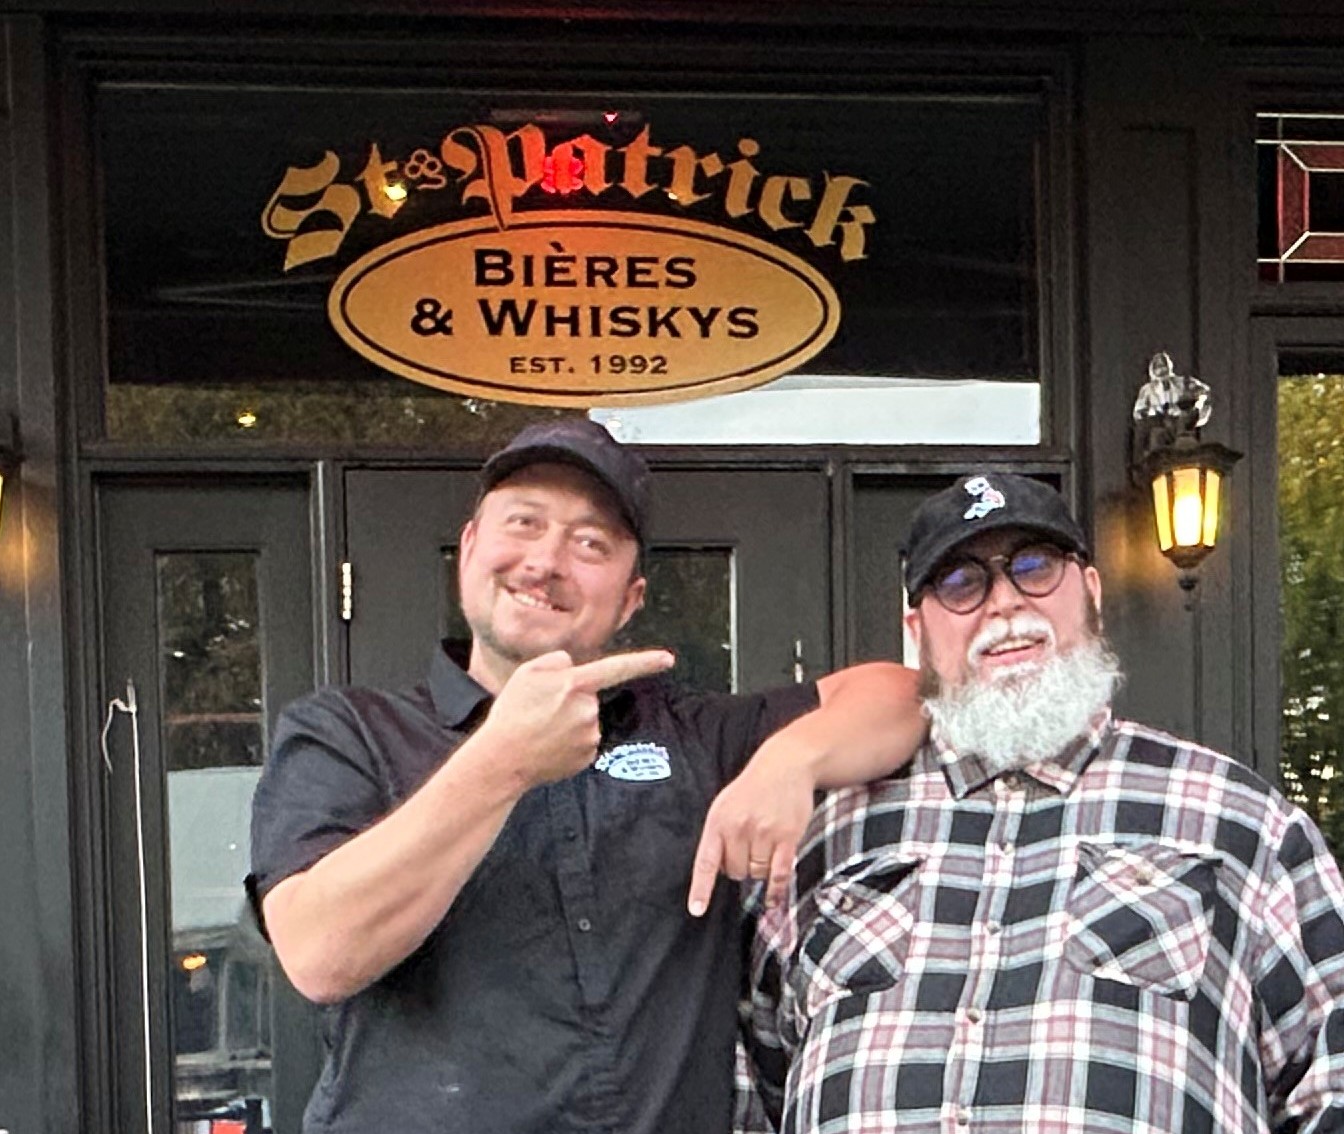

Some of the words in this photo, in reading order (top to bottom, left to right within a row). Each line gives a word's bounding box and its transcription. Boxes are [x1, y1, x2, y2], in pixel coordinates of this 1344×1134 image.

[261, 142, 407, 271] St
[442, 123, 876, 262] Patrick
[475, 241, 697, 289] BIÈRES
[410, 300, 454, 338] &
[479, 298, 760, 340] WHISKYS
[509, 355, 575, 374] EST.
[589, 354, 669, 375] 1992
